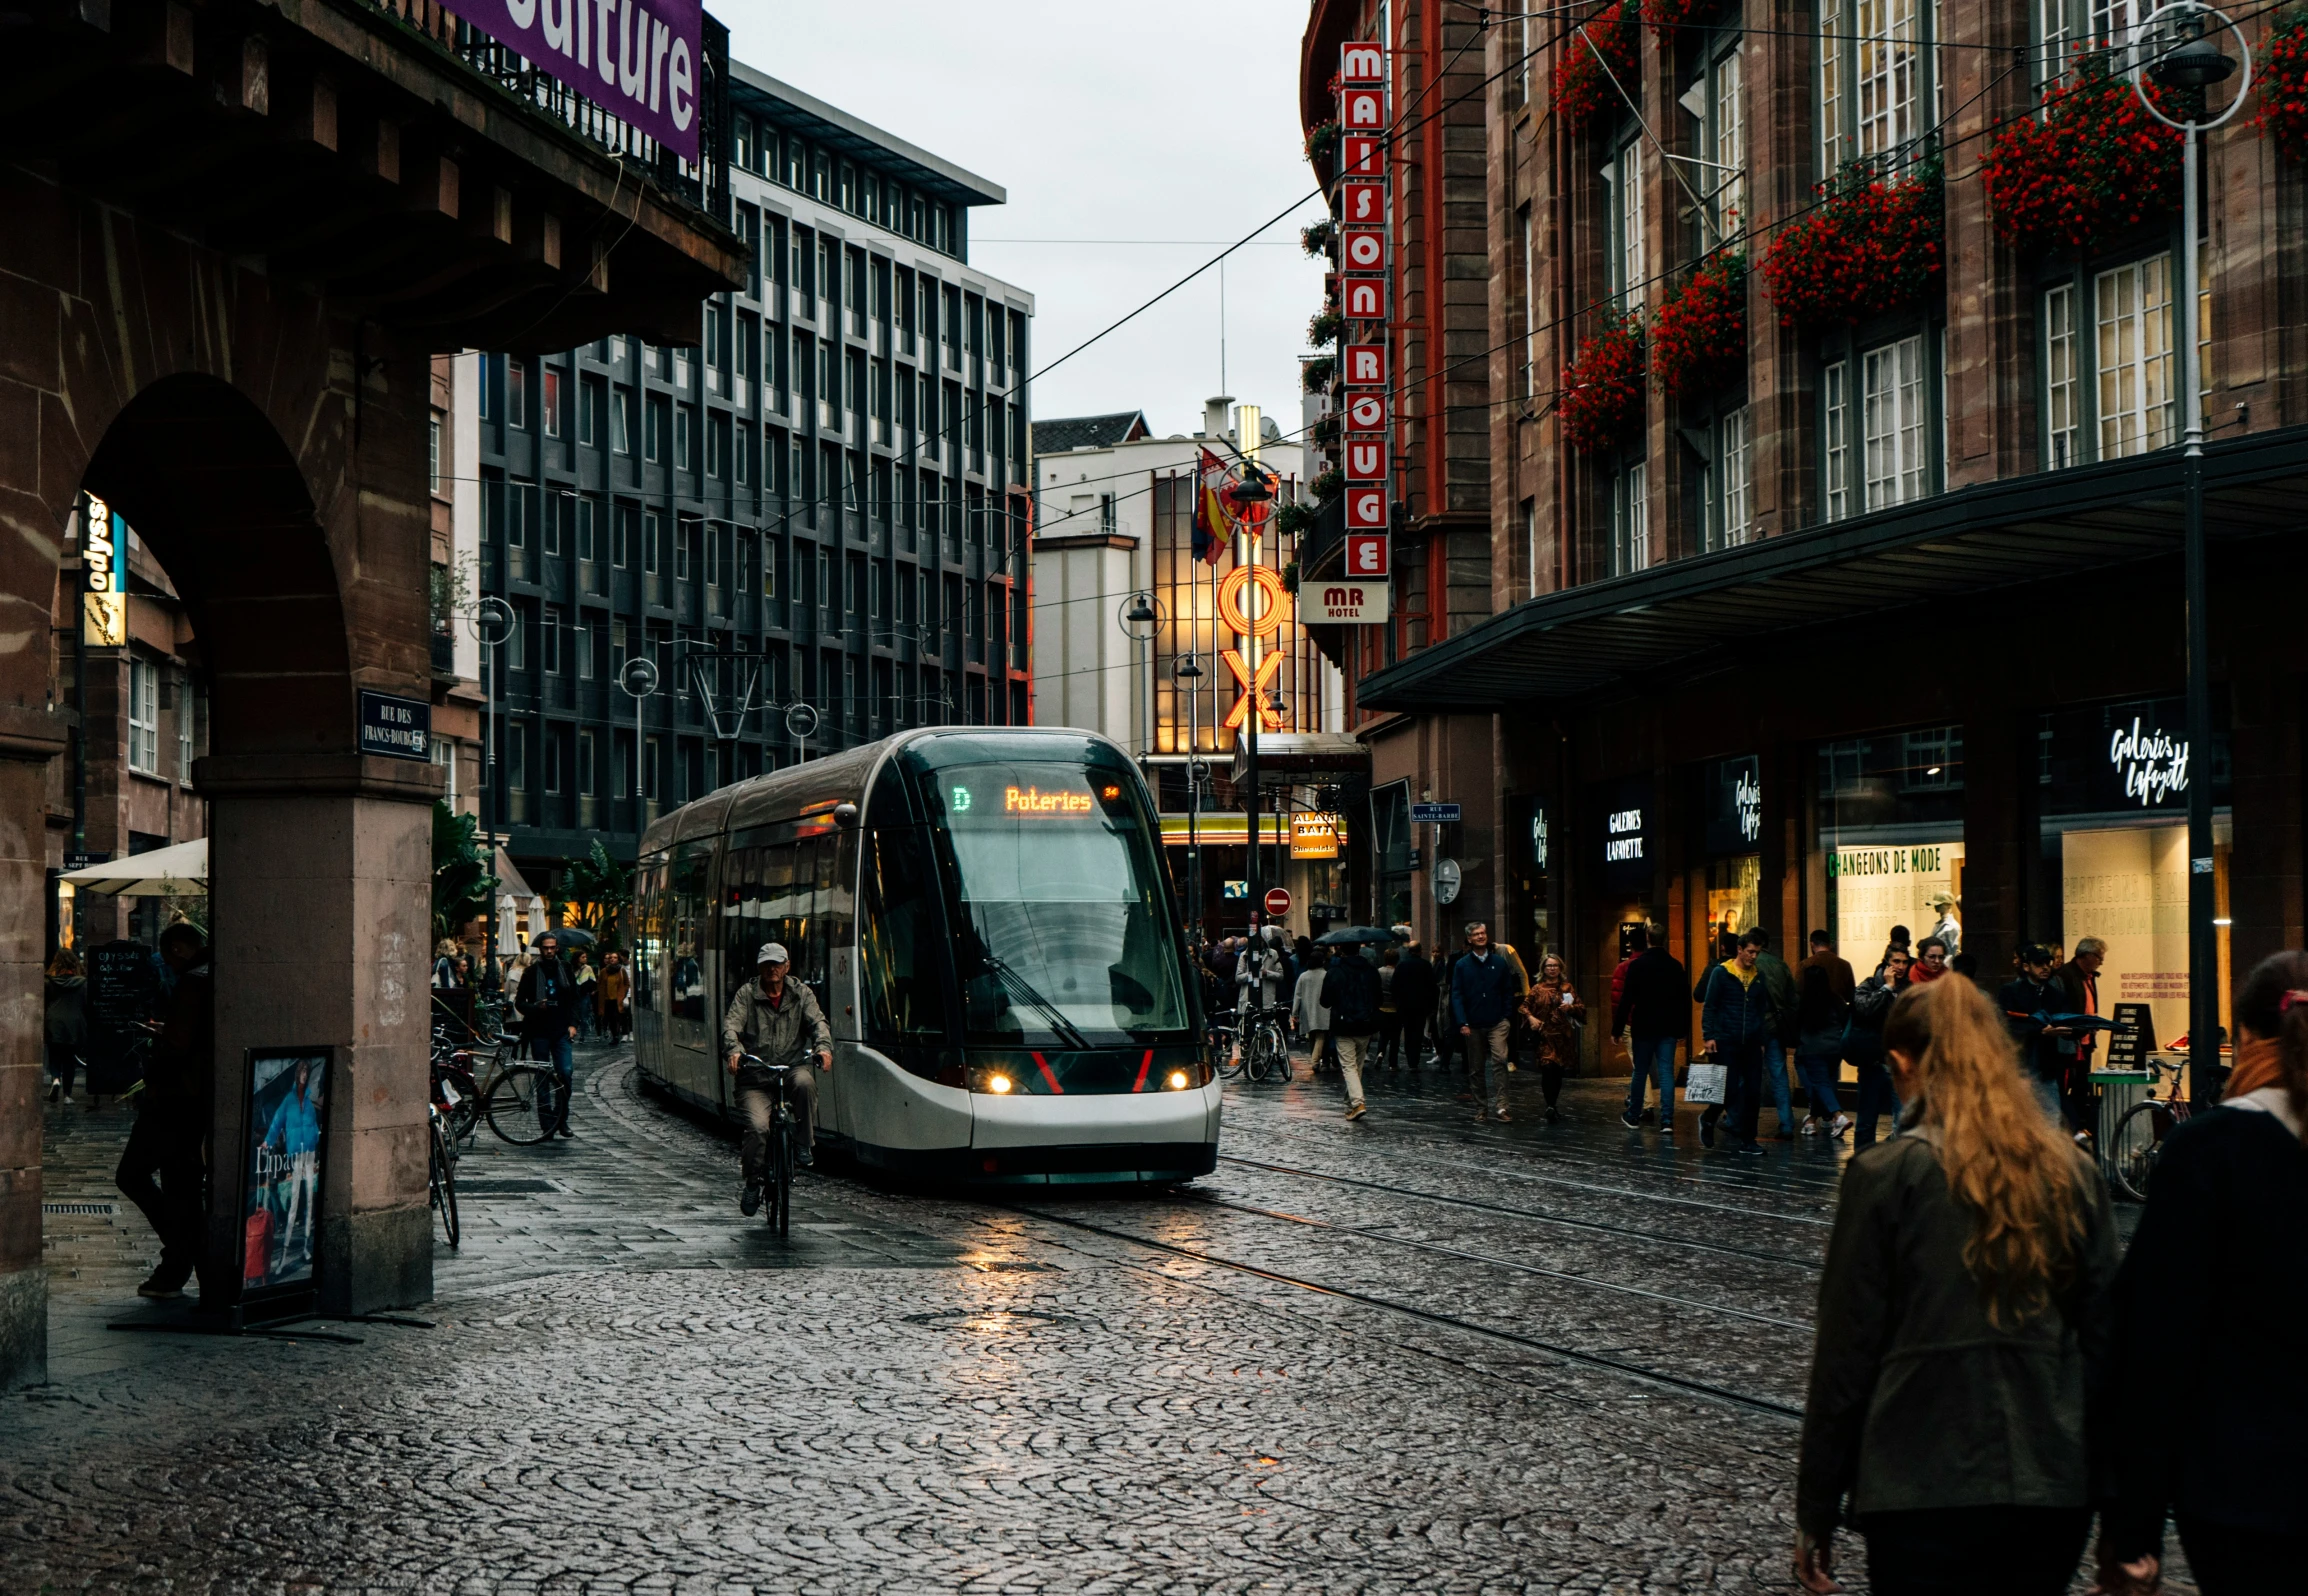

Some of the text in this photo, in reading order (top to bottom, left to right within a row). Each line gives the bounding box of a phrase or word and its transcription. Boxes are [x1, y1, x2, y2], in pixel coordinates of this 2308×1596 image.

[1345, 48, 1382, 570] MAISON ROUGE
[1323, 587, 1364, 606] MR
[1328, 608, 1360, 618] HOTEL
[381, 705, 412, 724] RUE DES
[2110, 716, 2174, 774] Galeries
[952, 786, 971, 813] D
[1005, 785, 1093, 811] Poteries
[1293, 812, 1337, 824] ALAIN
[1297, 825, 1332, 837] BATT
[1609, 808, 1642, 834] GALERIES
[1607, 836, 1643, 862] LAFAYETTE
[1828, 847, 1941, 878] CHANGEONS DE MODE
